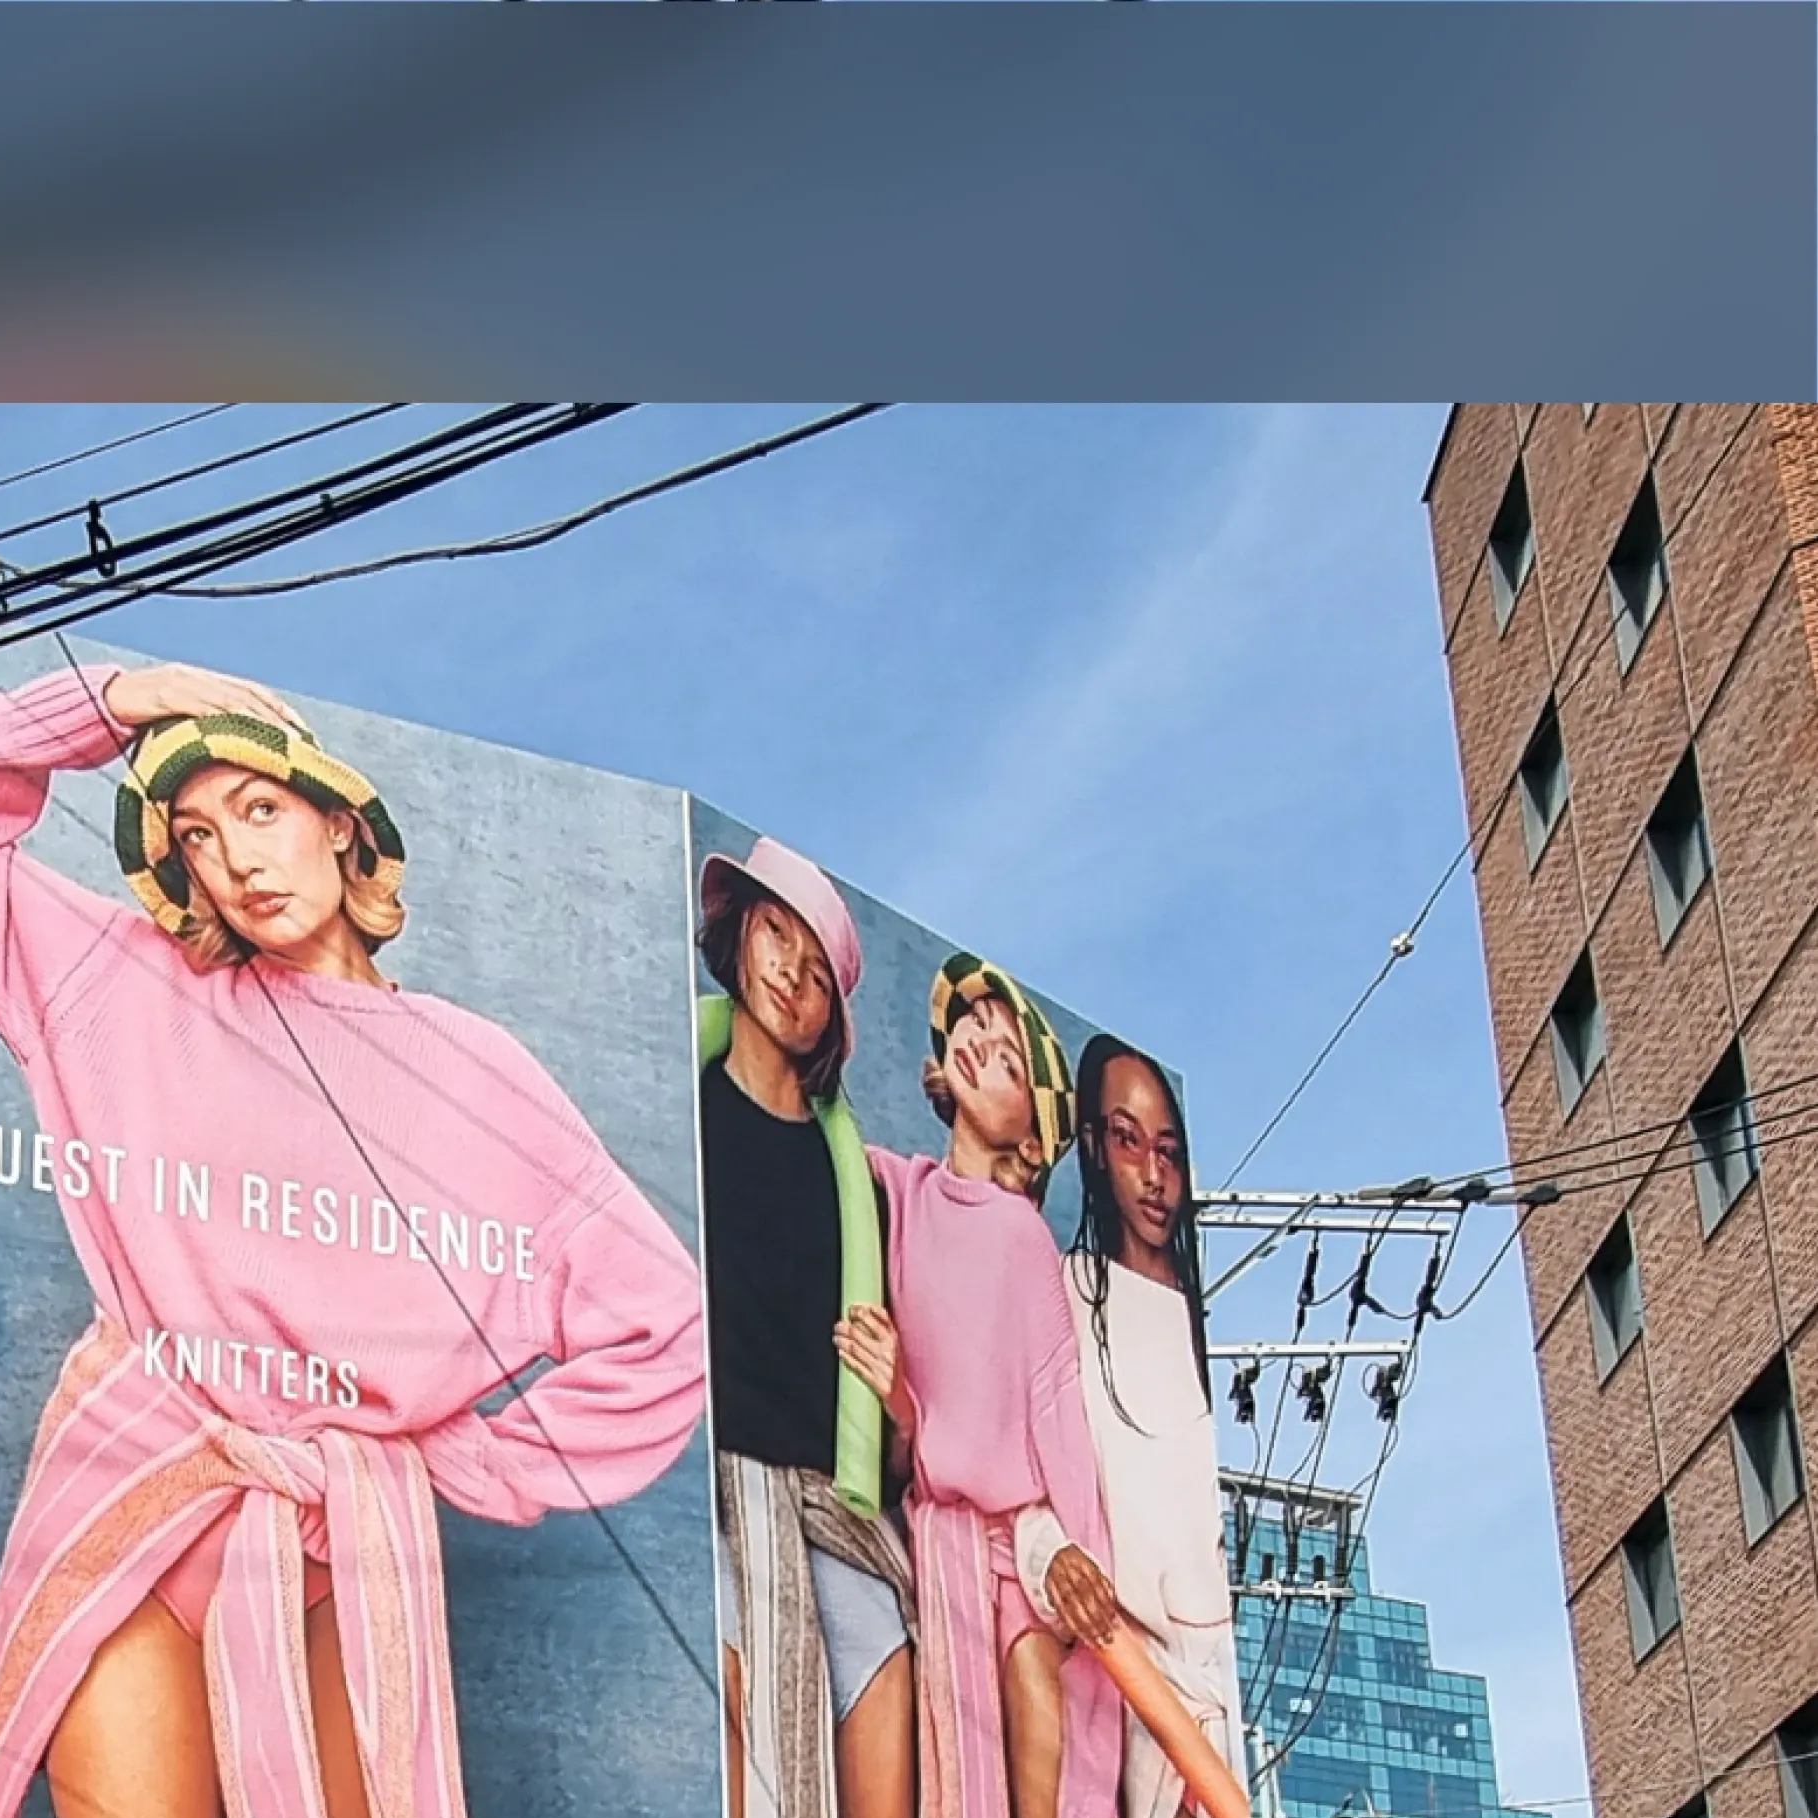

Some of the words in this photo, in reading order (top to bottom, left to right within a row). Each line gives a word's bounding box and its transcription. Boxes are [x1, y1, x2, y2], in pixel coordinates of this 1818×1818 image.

[152, 1155, 211, 1222] IN
[240, 1171, 537, 1282] RESIDENCE
[142, 1328, 361, 1410] KNITTERS
